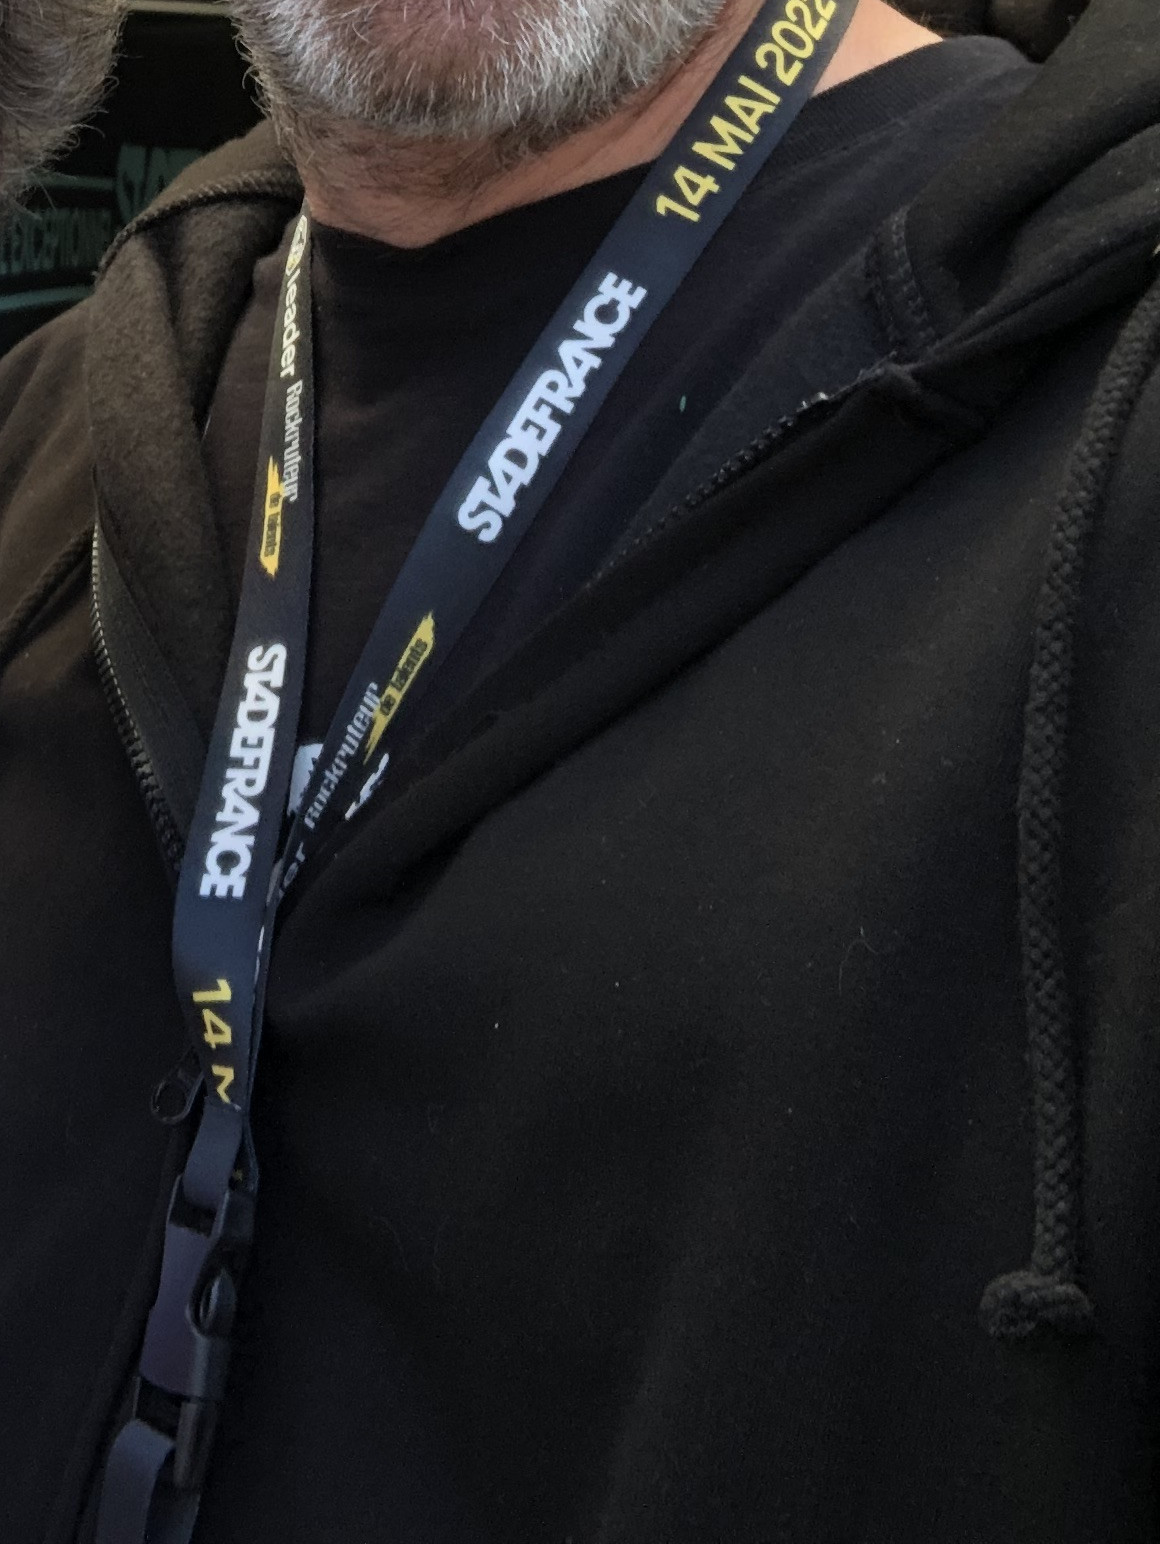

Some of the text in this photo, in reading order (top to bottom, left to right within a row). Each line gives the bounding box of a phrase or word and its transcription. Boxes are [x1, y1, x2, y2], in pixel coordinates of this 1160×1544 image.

[655, 163, 722, 223] 14
[691, 74, 782, 173] MAI
[280, 267, 302, 379] leader
[457, 271, 647, 545] STADEFRANCE
[199, 642, 288, 900] STADEFRANCE
[192, 979, 233, 1049] 14
